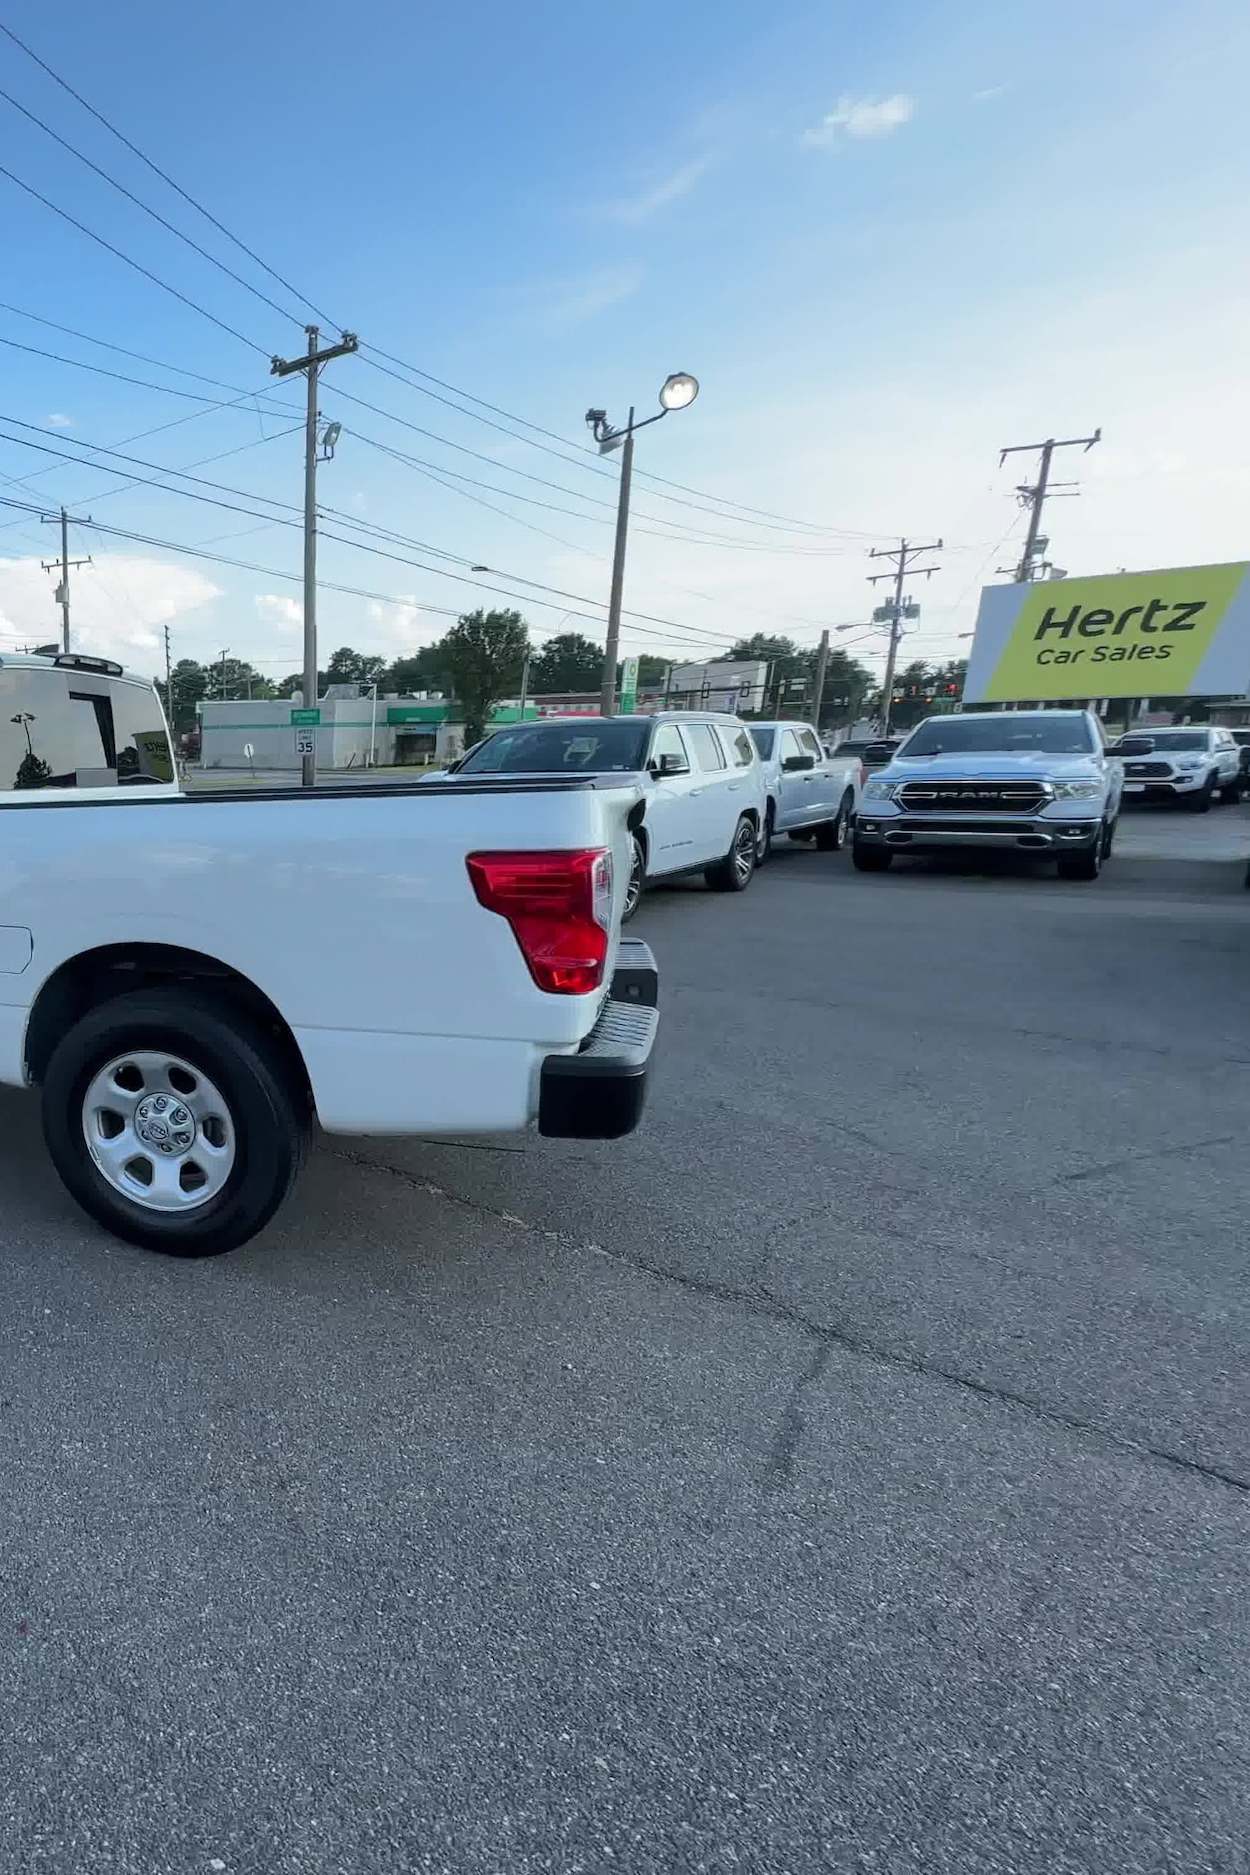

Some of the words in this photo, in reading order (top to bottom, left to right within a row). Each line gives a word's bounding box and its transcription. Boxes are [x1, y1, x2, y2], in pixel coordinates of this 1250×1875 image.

[1033, 599, 1206, 641] Hertz
[1036, 649, 1085, 665] Car
[1091, 644, 1173, 662] Sales
[297, 742, 313, 753] 35
[938, 791, 998, 799] RAM
